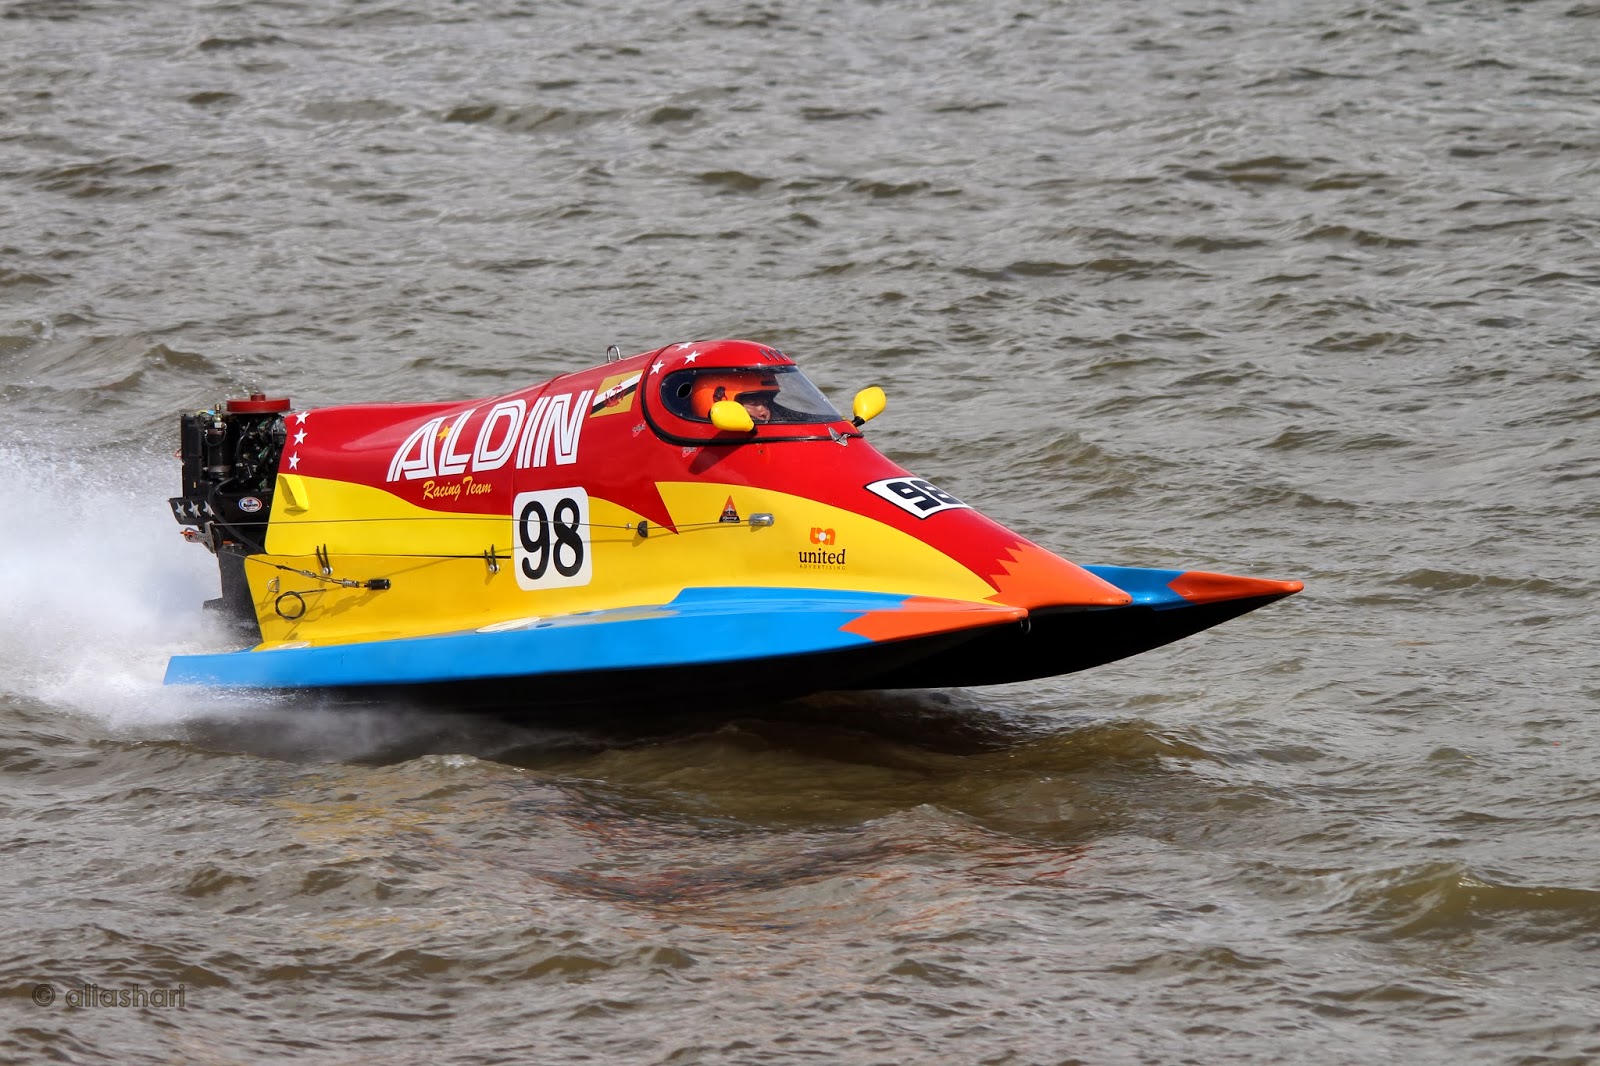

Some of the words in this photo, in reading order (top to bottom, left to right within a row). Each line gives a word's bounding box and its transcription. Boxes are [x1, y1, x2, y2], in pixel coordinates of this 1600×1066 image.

[386, 389, 595, 482] ALDIN
[423, 480, 461, 501] Racing
[463, 476, 492, 496] Team
[886, 480, 963, 511] 98
[519, 498, 584, 580] 98
[799, 547, 846, 565] united
